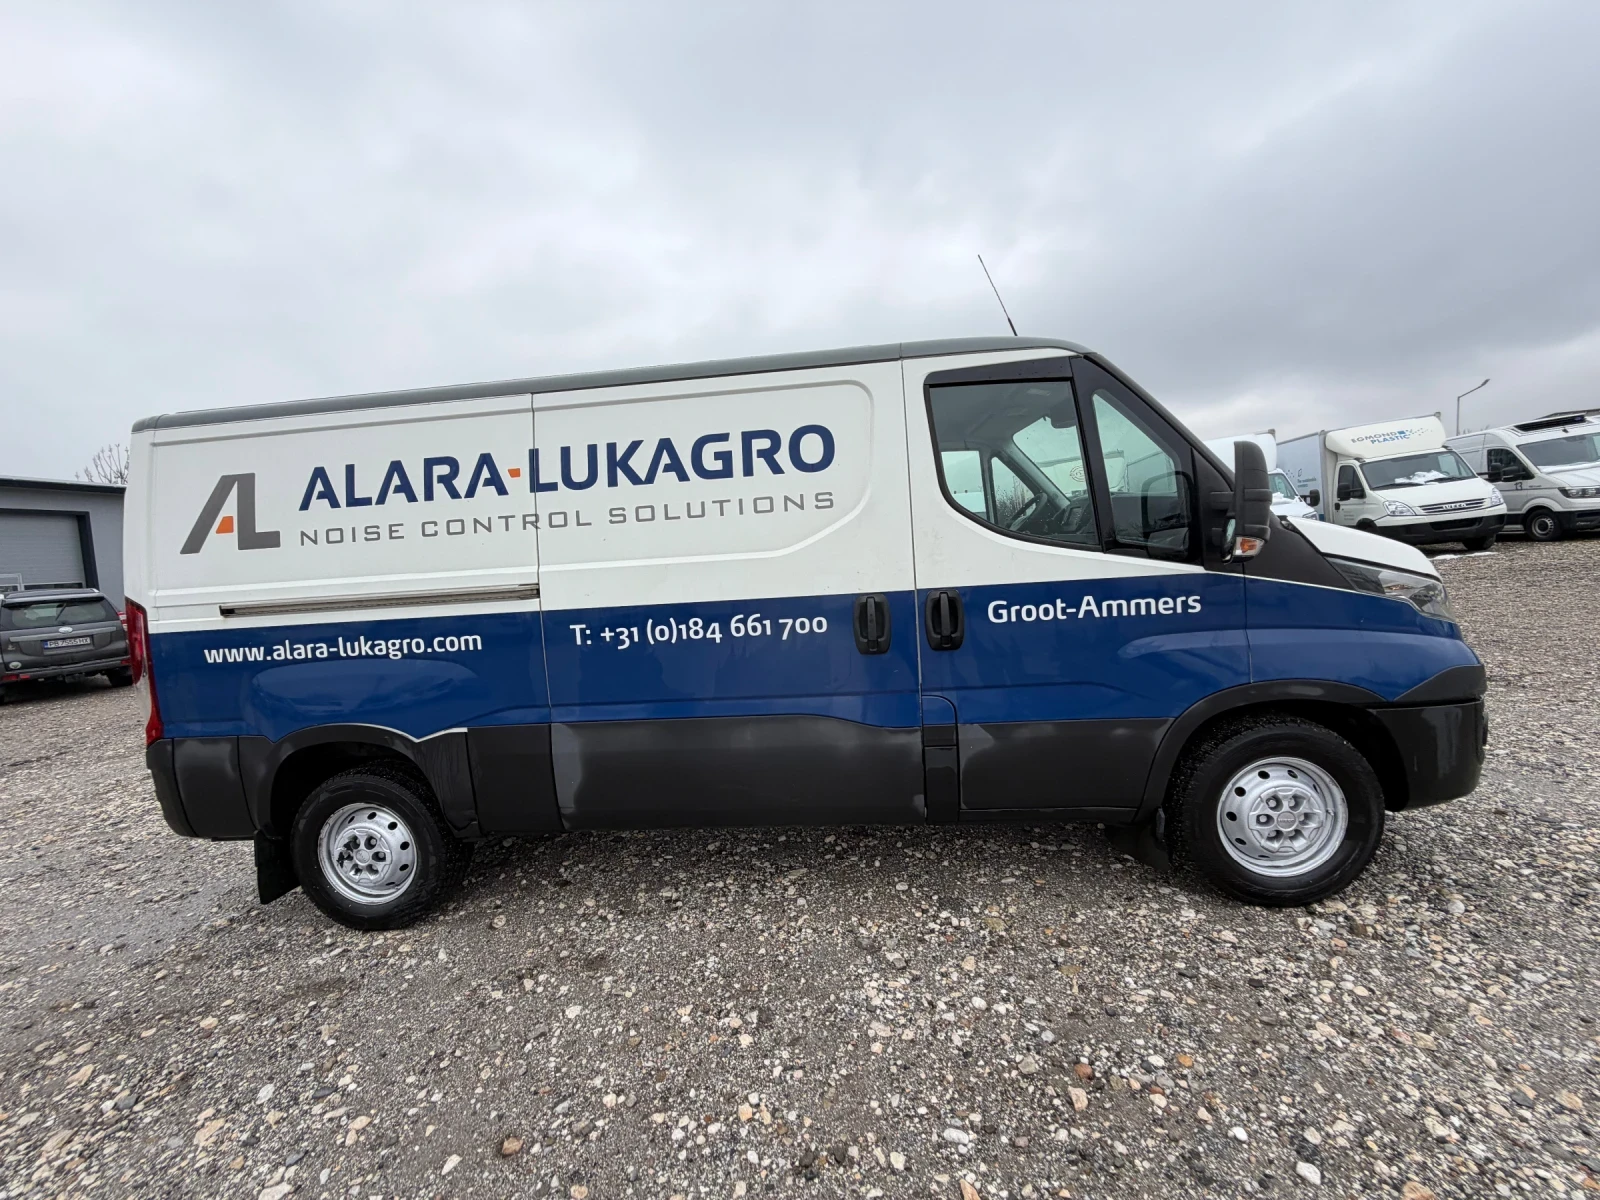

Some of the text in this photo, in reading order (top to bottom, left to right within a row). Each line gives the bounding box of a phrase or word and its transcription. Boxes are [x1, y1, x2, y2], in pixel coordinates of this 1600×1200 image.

[1351, 431, 1397, 443] EGMOND
[1370, 434, 1410, 445] PLASTIC
[300, 491, 835, 546] NOISE CONTROL SOLUTIONS
[987, 595, 1202, 624] Groot-Ammers
[570, 613, 828, 649] T: +31 (0)184 661 700
[204, 634, 483, 664] www.alara-lukagro.com
